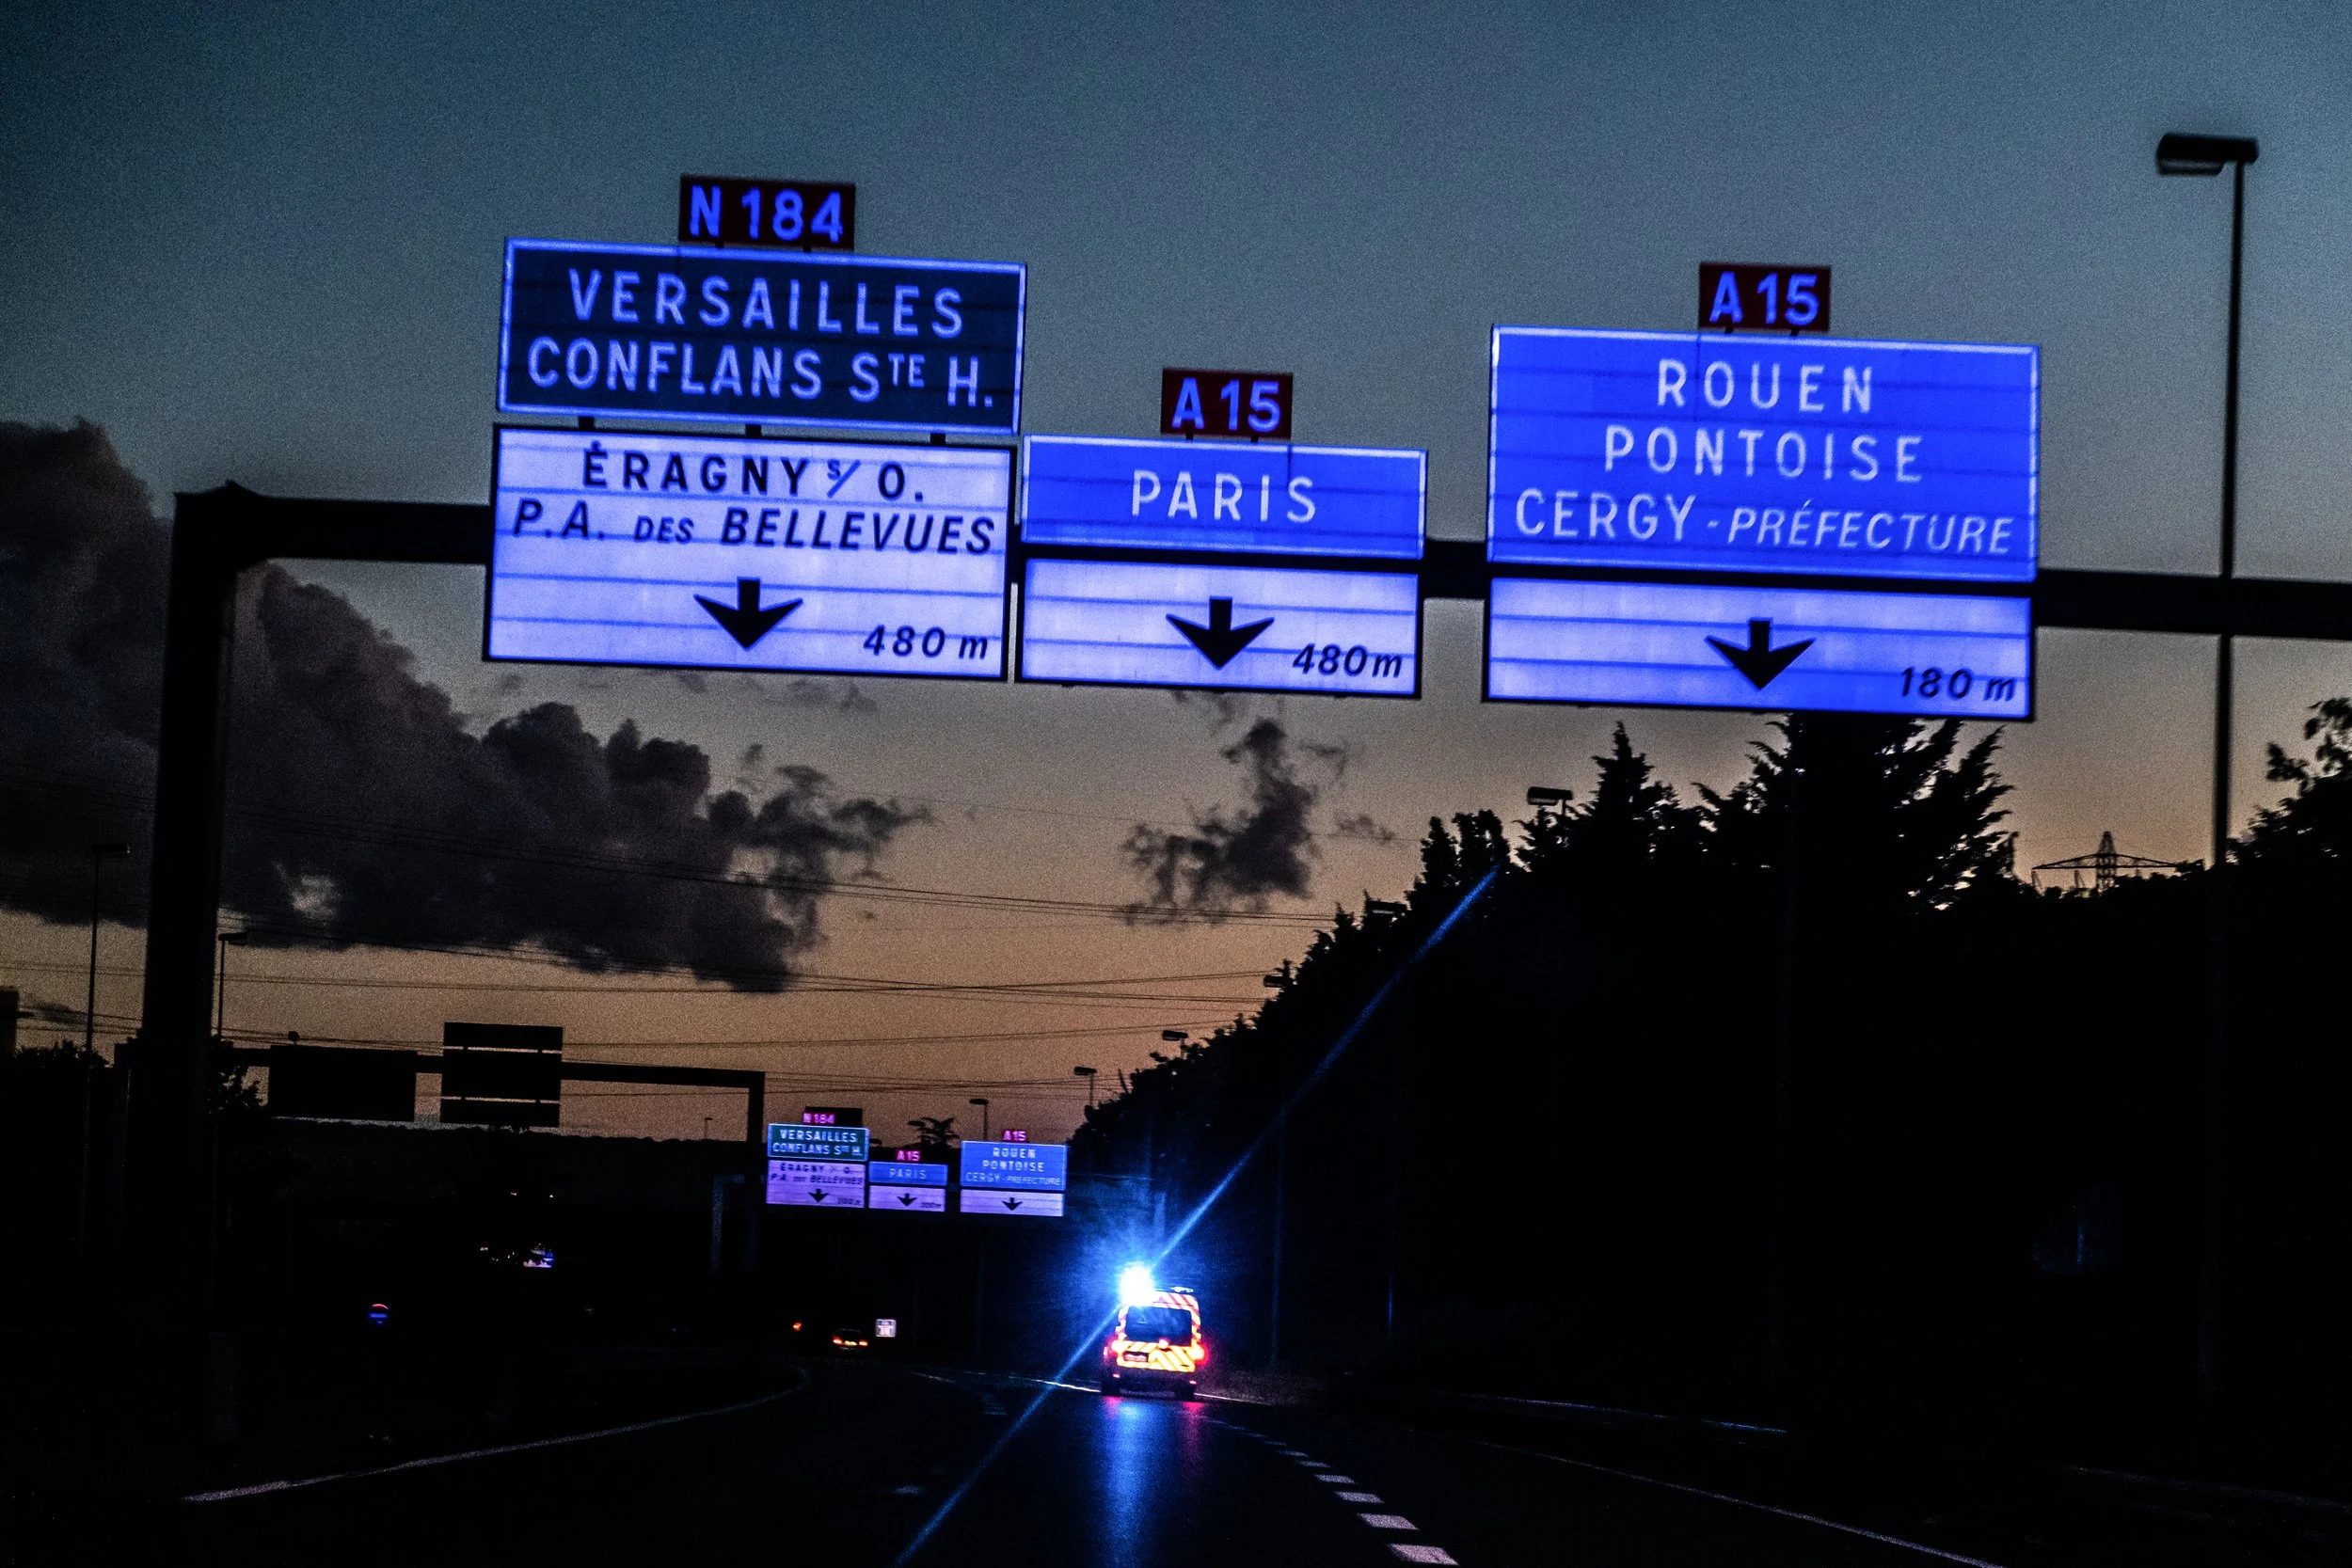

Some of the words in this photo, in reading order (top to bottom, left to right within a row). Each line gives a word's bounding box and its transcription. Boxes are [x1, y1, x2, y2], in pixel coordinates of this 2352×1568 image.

[689, 184, 722, 237] N
[741, 188, 844, 242] 184
[568, 268, 963, 340] VERSAILLES
[1708, 271, 1743, 324] A
[1756, 273, 1820, 326] 15
[527, 337, 823, 400] CONFLANS
[946, 356, 993, 407] H.
[1657, 358, 1873, 413] ROUEN
[1171, 377, 1205, 429] A
[1219, 379, 1282, 433] 15
[581, 441, 810, 495] ÉRAGNY
[877, 462, 925, 502] O.
[1604, 424, 1923, 483] PONTOISE
[1131, 469, 1317, 523] PARIS
[513, 498, 607, 541] P.A.
[633, 515, 696, 545] DES
[721, 506, 995, 556] BELLEVUES
[863, 624, 946, 658] 480
[958, 634, 990, 660] m
[1292, 642, 1368, 677] 480
[1371, 652, 1403, 678] m
[1899, 665, 1975, 702] 180
[1983, 676, 2017, 703] m
[780, 1129, 858, 1143] VERSAILLES
[814, 1114, 835, 1124] 184
[1003, 1130, 1011, 1141] A
[1012, 1131, 1026, 1141] 15
[772, 1142, 830, 1155] CONFLANS
[897, 1149, 905, 1161] A
[906, 1150, 920, 1162] 15
[981, 1159, 1044, 1173] PONTOISE
[993, 1147, 1036, 1159] ROUEN
[888, 1167, 926, 1180] PARIS
